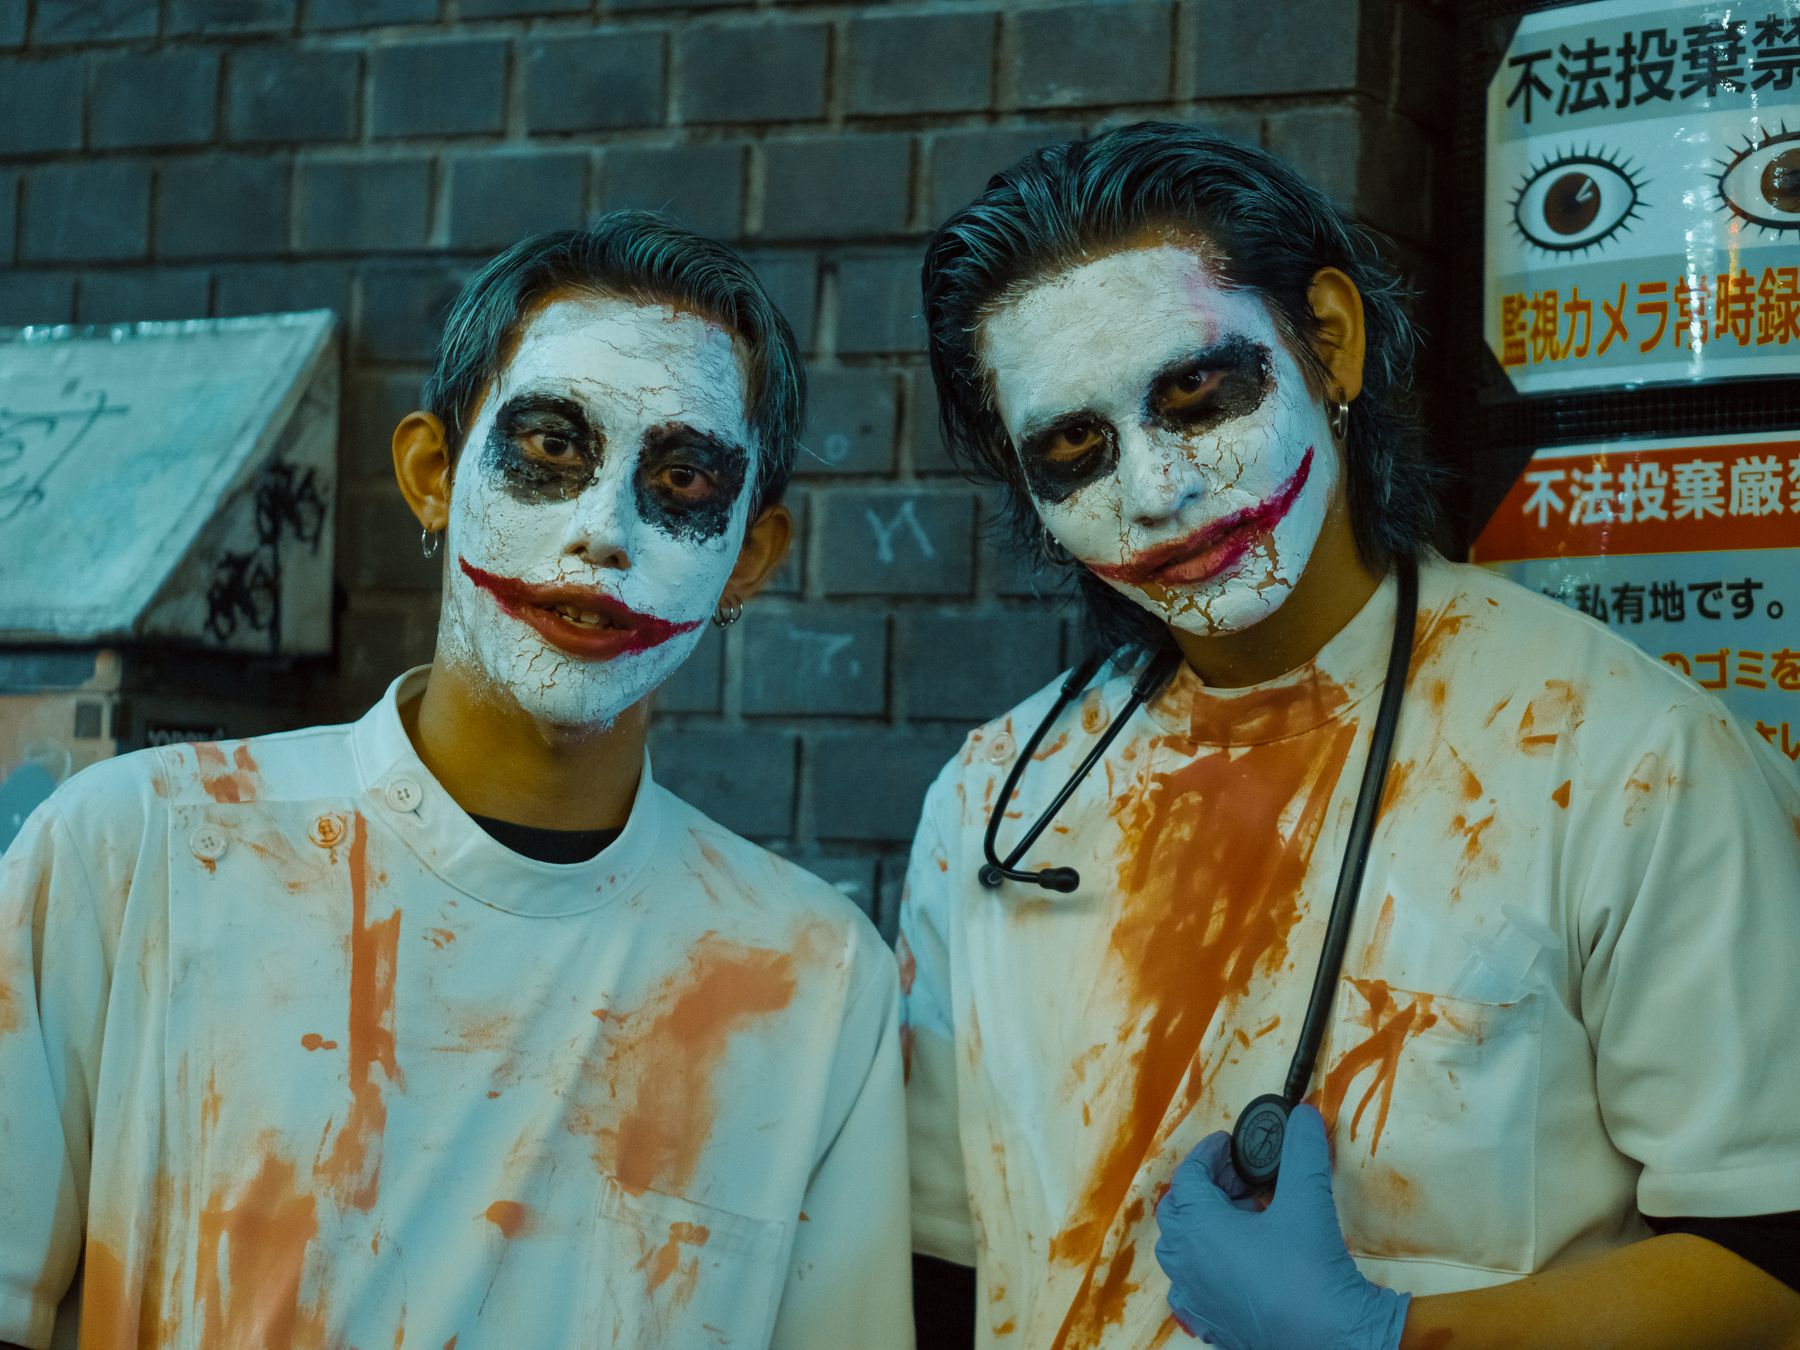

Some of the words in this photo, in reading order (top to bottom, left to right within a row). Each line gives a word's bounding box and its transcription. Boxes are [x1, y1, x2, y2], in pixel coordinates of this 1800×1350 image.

[1505, 12, 1800, 124] 不法投棄禁
[1522, 454, 1800, 529] 不法投棄厳
[1541, 577, 1784, 624] 私有地です。
